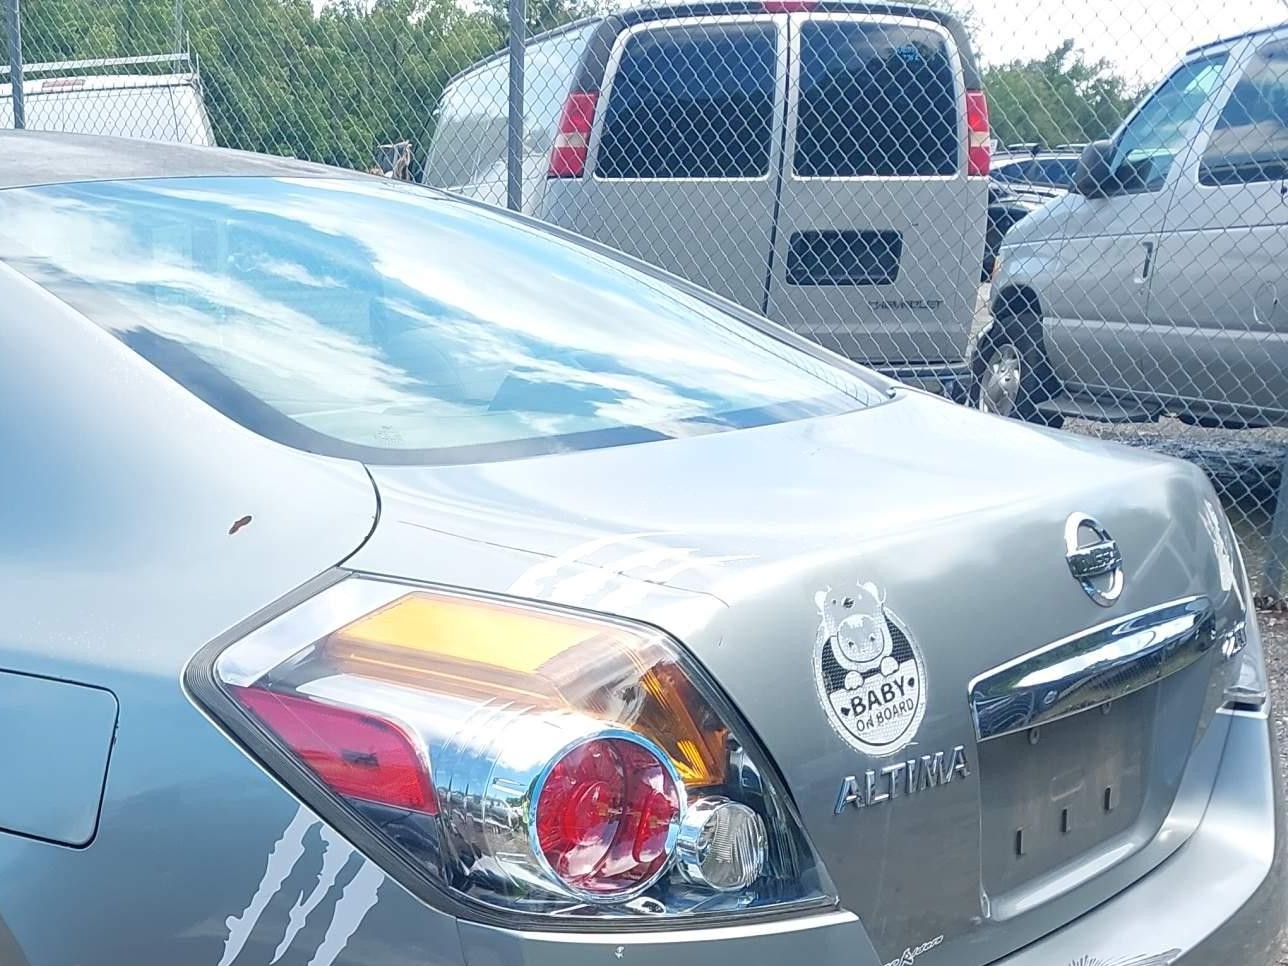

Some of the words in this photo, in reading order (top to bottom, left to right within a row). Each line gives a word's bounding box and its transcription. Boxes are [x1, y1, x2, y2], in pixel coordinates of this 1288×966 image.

[850, 675, 906, 717] BABY
[877, 698, 915, 726] BOARD
[834, 744, 971, 816] ALTIMA
